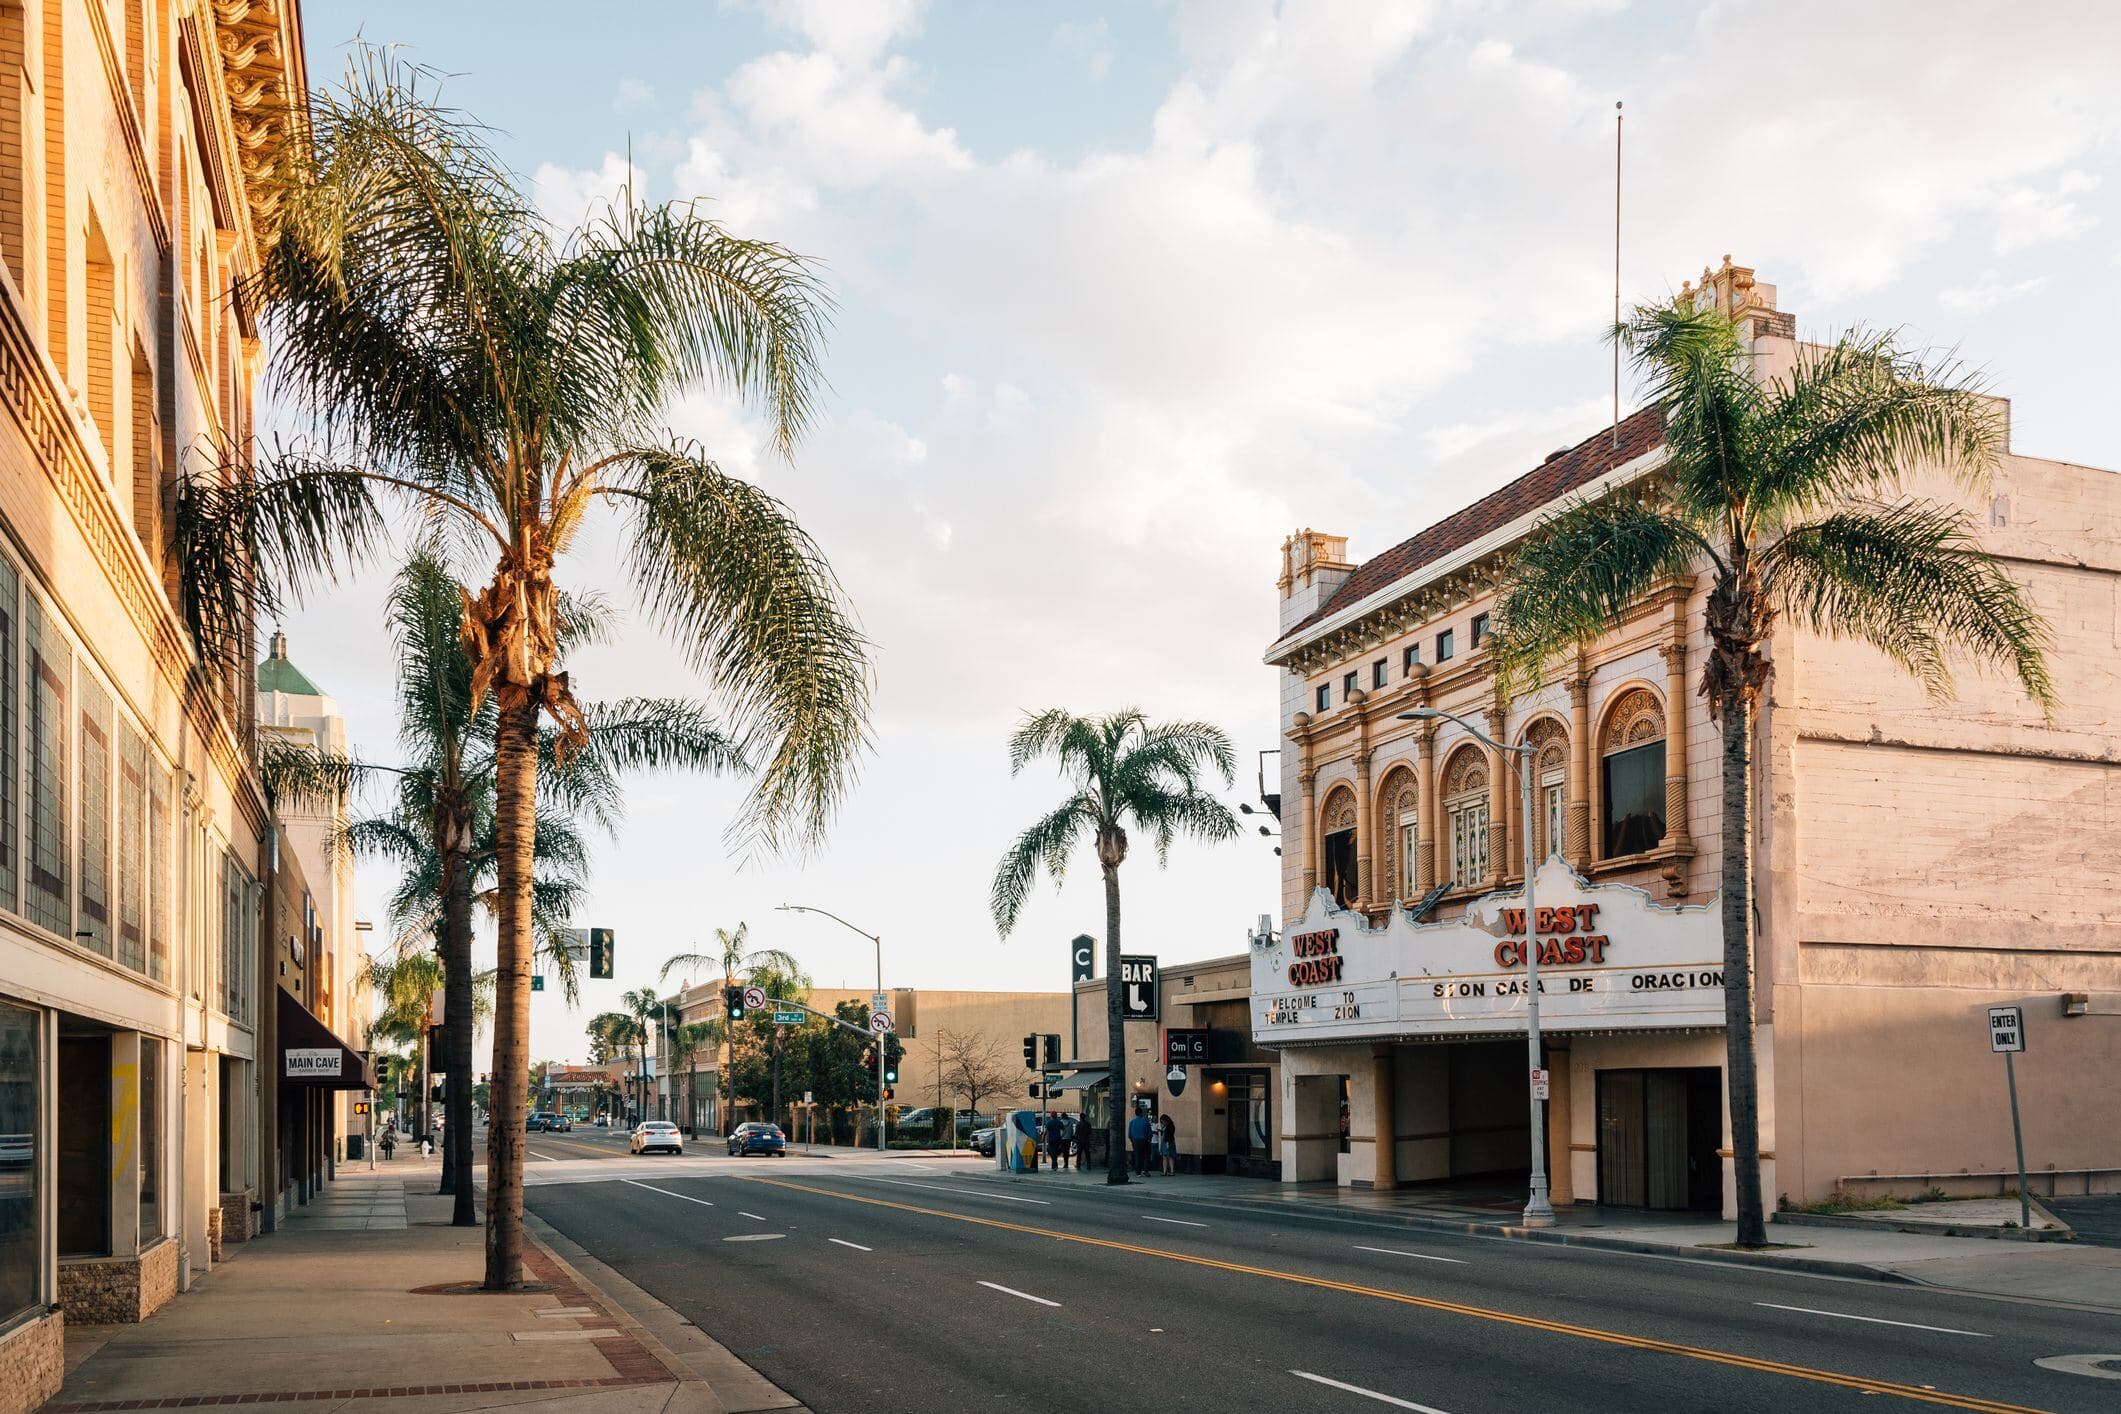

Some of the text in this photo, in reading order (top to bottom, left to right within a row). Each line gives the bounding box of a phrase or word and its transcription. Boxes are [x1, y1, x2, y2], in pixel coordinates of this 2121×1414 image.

[1502, 903, 1600, 934] WEST
[1292, 928, 1340, 957] WEST
[1494, 935, 1609, 968] COAST
[1121, 963, 1153, 982] BAR
[1288, 956, 1343, 985] COAST
[1569, 978, 1594, 992] DE
[1631, 972, 1725, 989] ORACION
[1272, 992, 1354, 1010] WELCOME TO
[1265, 1005, 1360, 1025] TEMPLE ZION
[1991, 1015, 2016, 1028] ENTER
[1193, 1041, 1203, 1052] G
[1995, 1032, 2015, 1045] ONLY
[288, 1057, 340, 1069] MAIN CAVE
